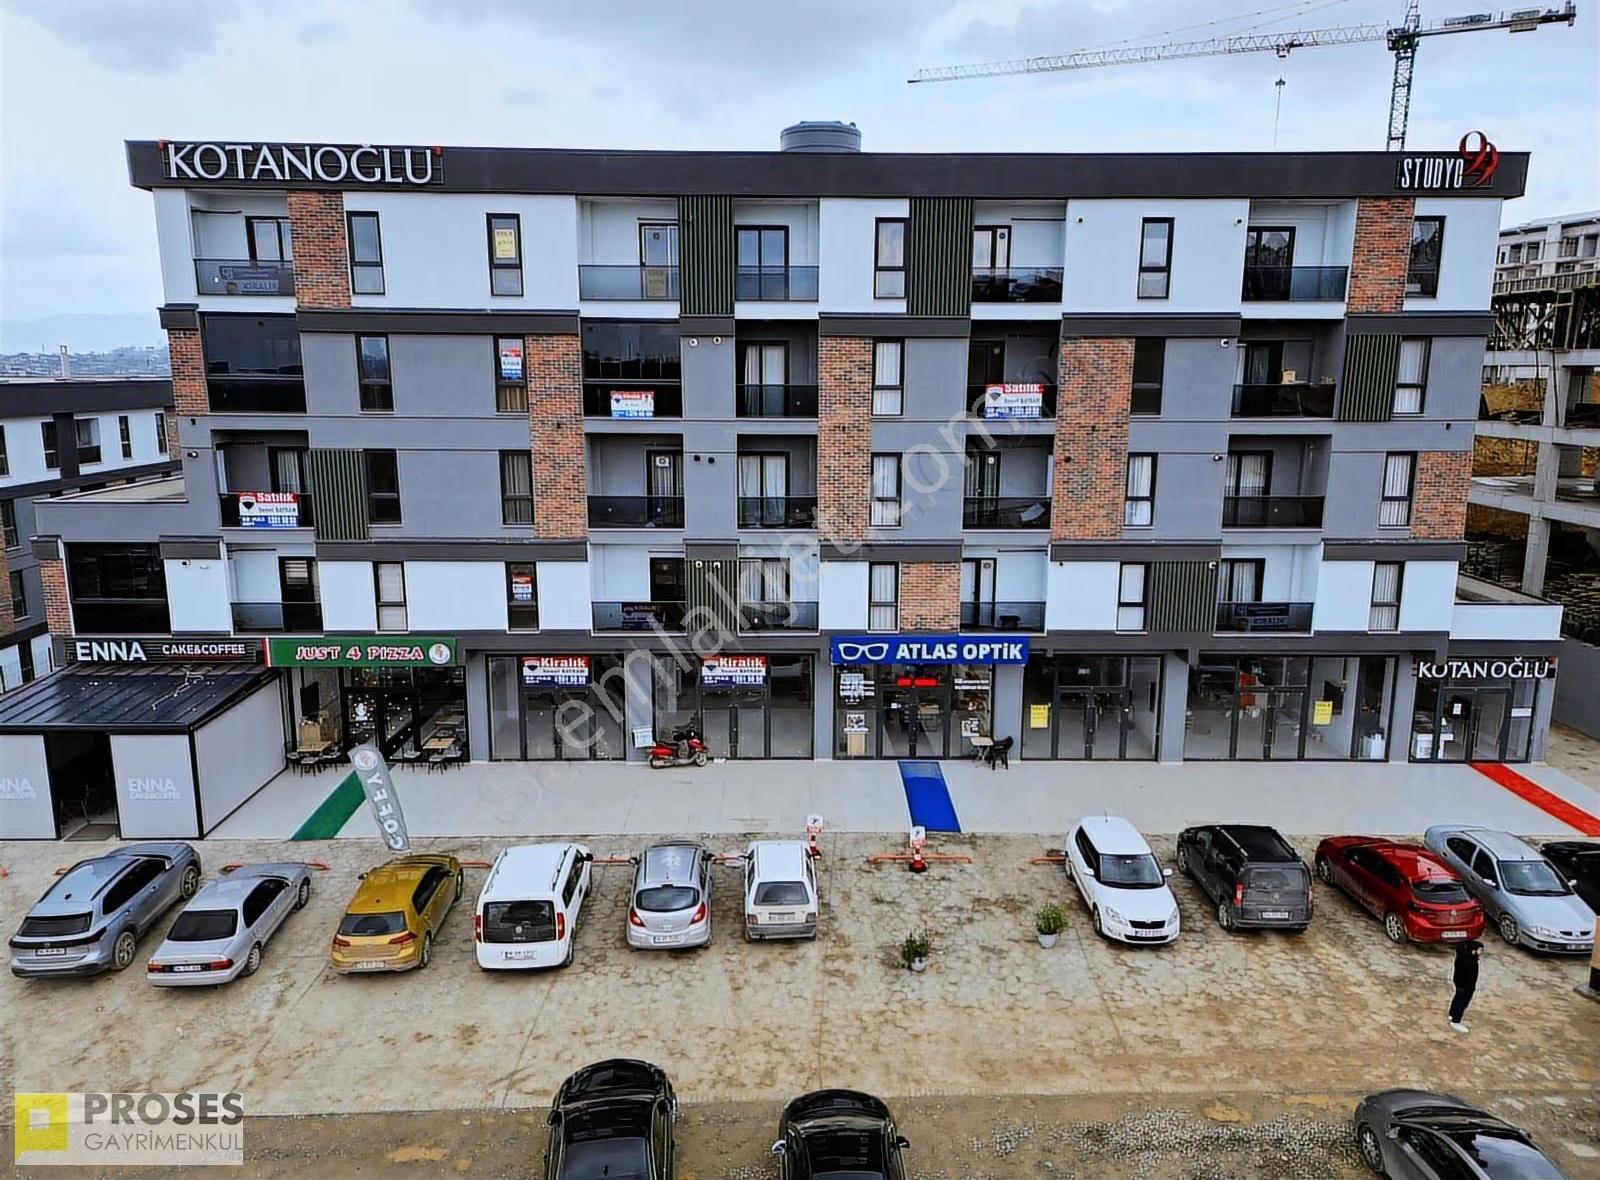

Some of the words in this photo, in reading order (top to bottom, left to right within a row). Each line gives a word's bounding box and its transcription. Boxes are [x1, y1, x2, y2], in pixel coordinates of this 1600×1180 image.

[167, 142, 432, 184] KOTANOĞLU
[1400, 157, 1465, 189] STUDYO
[75, 641, 147, 661] ENNA
[162, 644, 246, 655] CAKE&COFFEE
[295, 646, 341, 661] JUST
[346, 646, 361, 660] 4
[367, 646, 424, 661] PIZZA
[895, 643, 959, 660] ATLAS
[127, 777, 177, 792] ENNA
